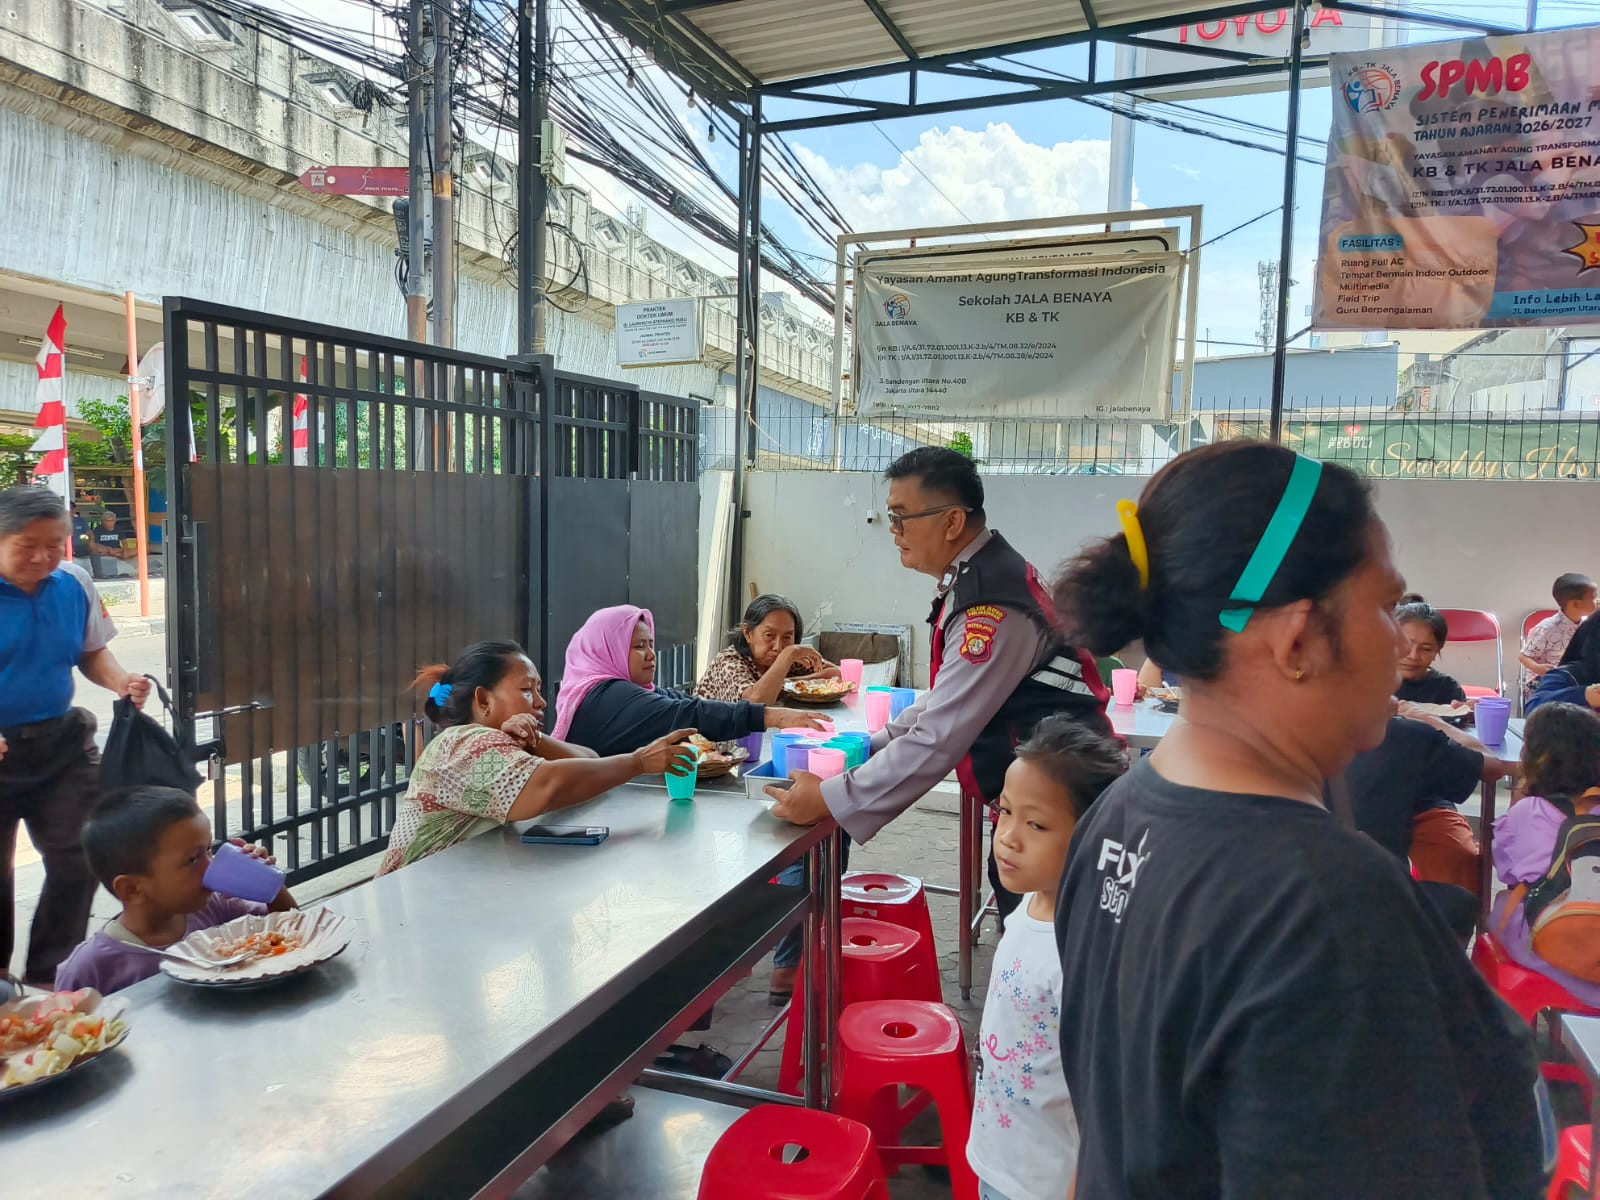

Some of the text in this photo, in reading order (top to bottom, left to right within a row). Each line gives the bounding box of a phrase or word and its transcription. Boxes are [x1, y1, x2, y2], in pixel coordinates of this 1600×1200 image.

[1179, 7, 1343, 44] TOYOA
[1417, 53, 1531, 102] SPMB
[1416, 111, 1472, 127] SISTEM
[1478, 101, 1581, 121] PENERIMAAN
[1413, 116, 1593, 142] TAHUN AJARAN 2026/2027
[1413, 151, 1456, 161] YAYASAN
[1458, 147, 1499, 157] AMANAT
[1501, 145, 1534, 154] AGUNG
[1412, 166, 1438, 178] KB
[1445, 164, 1456, 177] &
[1464, 162, 1488, 175] TK
[1495, 160, 1543, 173] JALA
[1342, 237, 1395, 249] FASILITAS
[1341, 257, 1405, 268] Ruang Full AC
[876, 274, 923, 287] Yayasan
[926, 273, 972, 284] Amanat
[1102, 262, 1166, 277] Indonesia
[1340, 268, 1489, 281] Tempat Bermain Indoor Outdoor
[1339, 282, 1390, 291] Multimedia
[958, 291, 1113, 307] Sekolah JALA BENAYA
[1337, 294, 1380, 303] Field Trip
[1513, 294, 1541, 305] Info
[1546, 292, 1581, 304] Lebih
[1336, 305, 1433, 316] Guru Berpengalaman
[1524, 305, 1576, 315] Bandengan
[1006, 311, 1060, 323] KB & TK
[921, 377, 940, 385] Utara
[1109, 405, 1151, 413] jalabenaya
[1328, 440, 1373, 449] PEDULI
